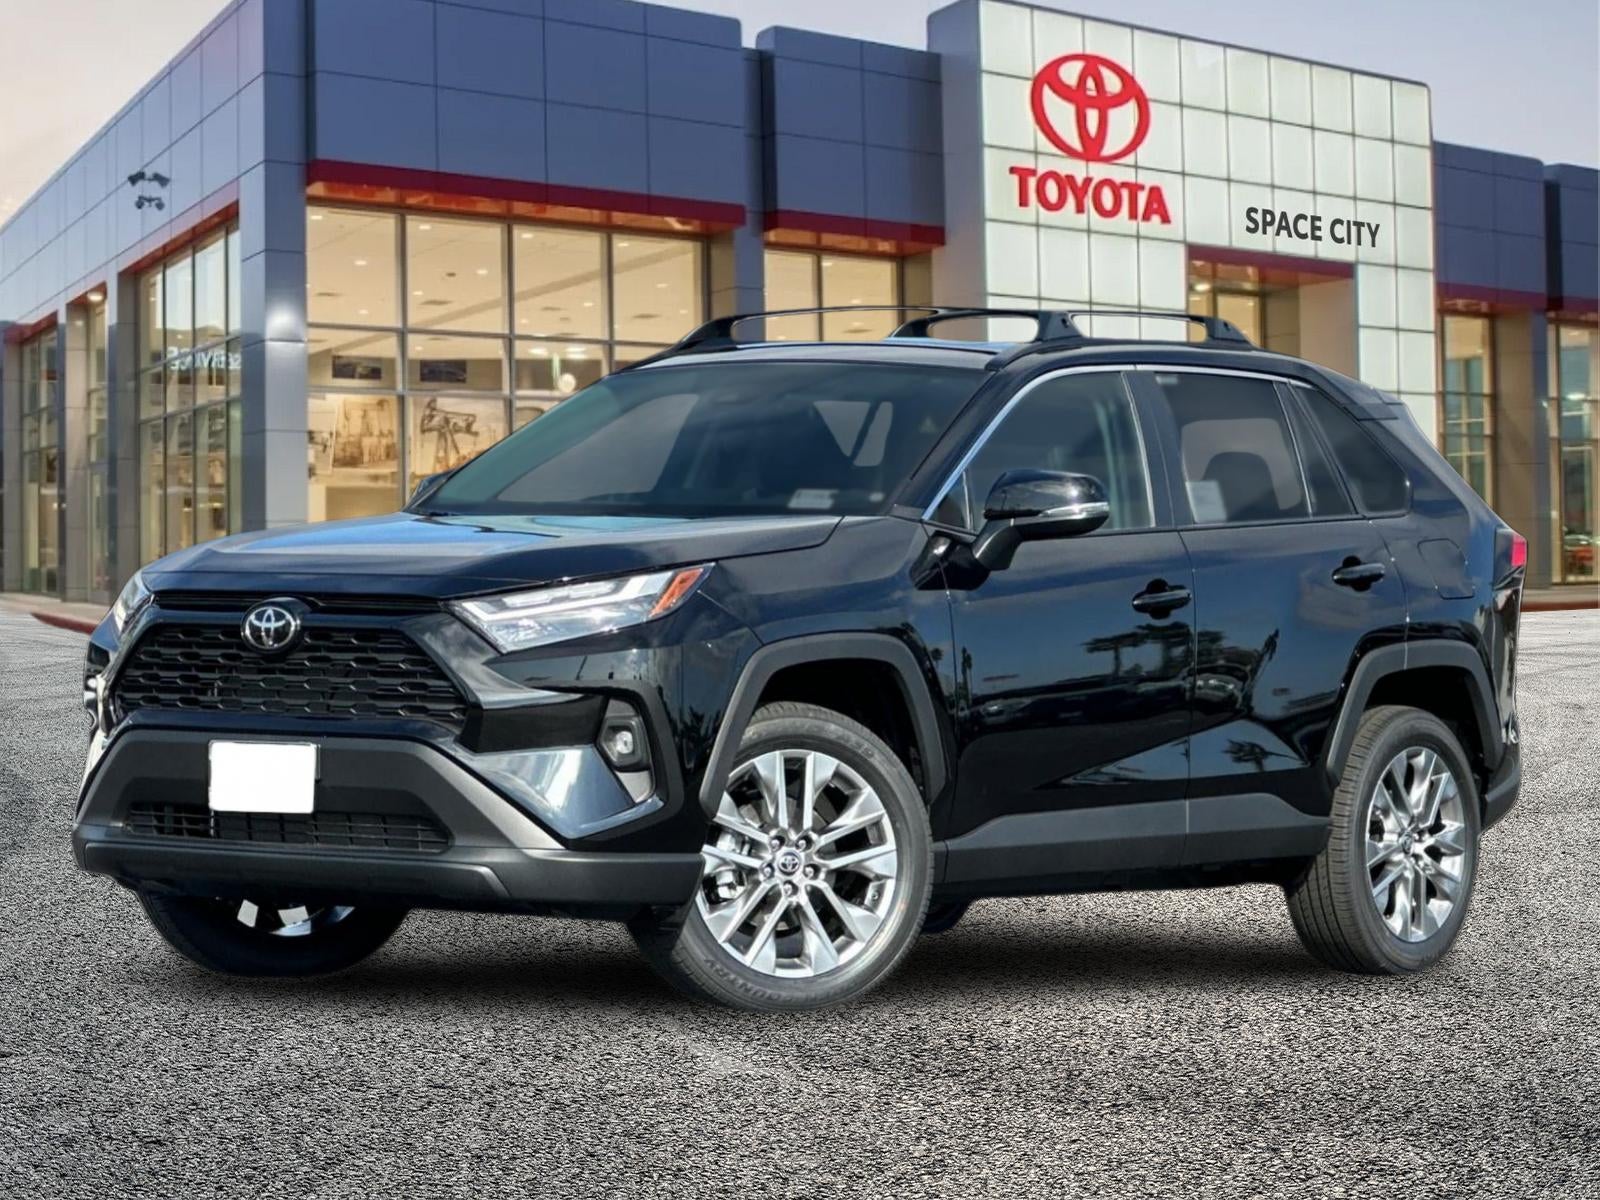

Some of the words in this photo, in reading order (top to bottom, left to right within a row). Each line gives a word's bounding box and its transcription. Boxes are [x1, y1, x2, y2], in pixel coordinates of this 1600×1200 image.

[1009, 166, 1171, 224] TOYOTA
[1245, 206, 1323, 241] SPACE
[1329, 218, 1380, 248] CITY
